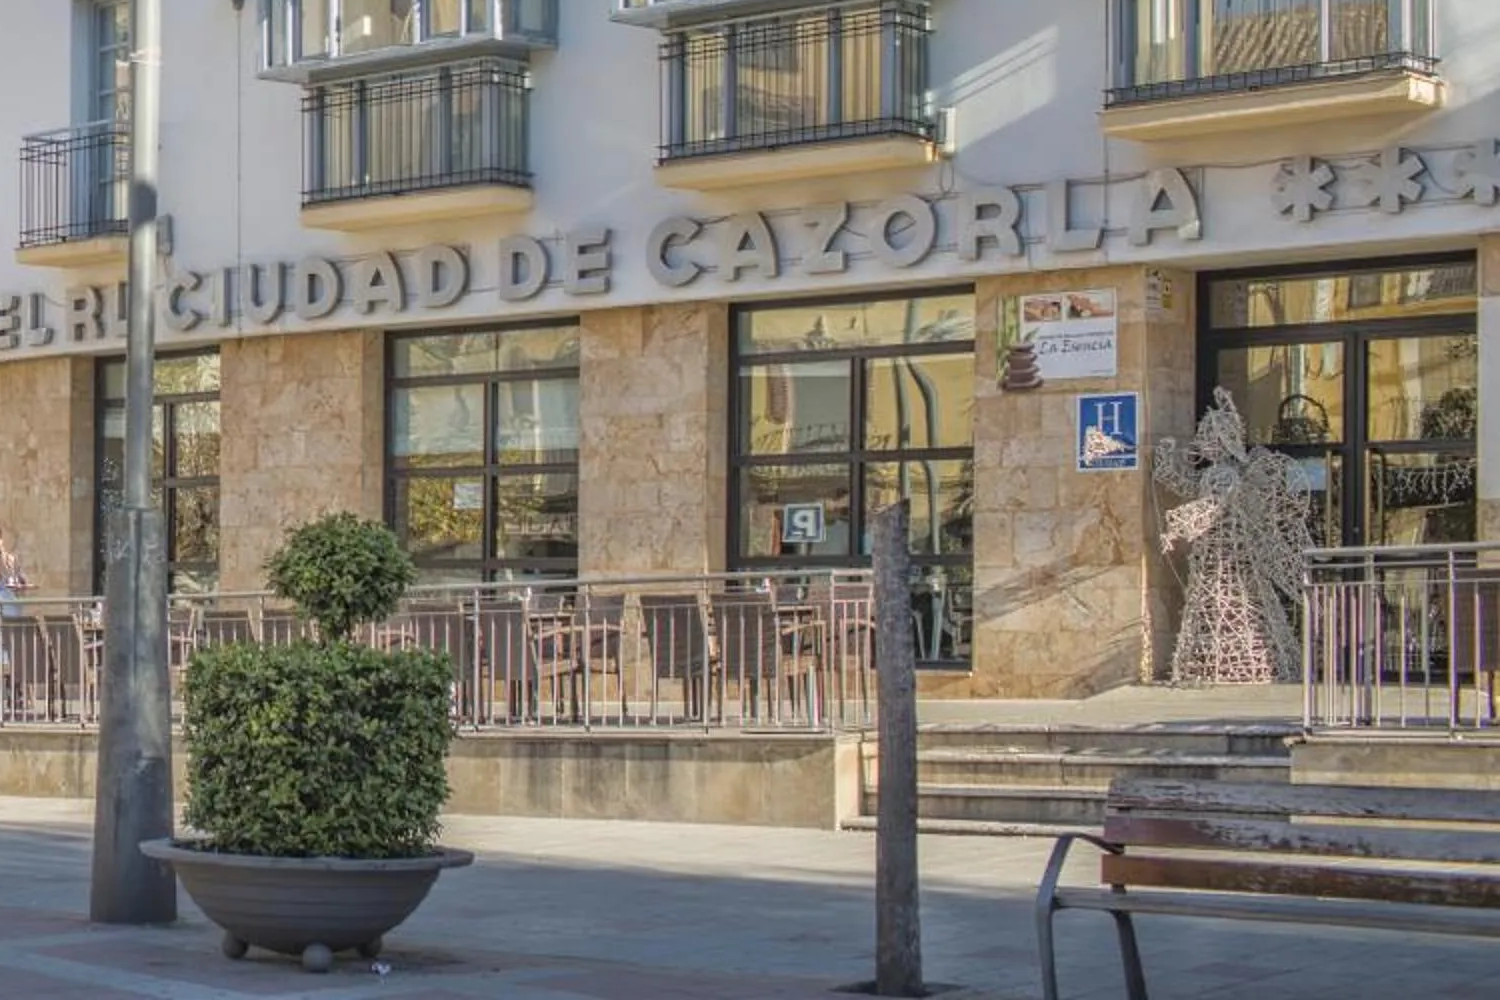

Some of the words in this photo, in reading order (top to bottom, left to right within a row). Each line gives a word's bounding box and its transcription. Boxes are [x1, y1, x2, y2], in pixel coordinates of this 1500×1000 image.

[164, 243, 471, 332] CIUDAD
[497, 227, 613, 303] DE
[645, 166, 1203, 288] CAZORLA
[1092, 401, 1124, 436] H
